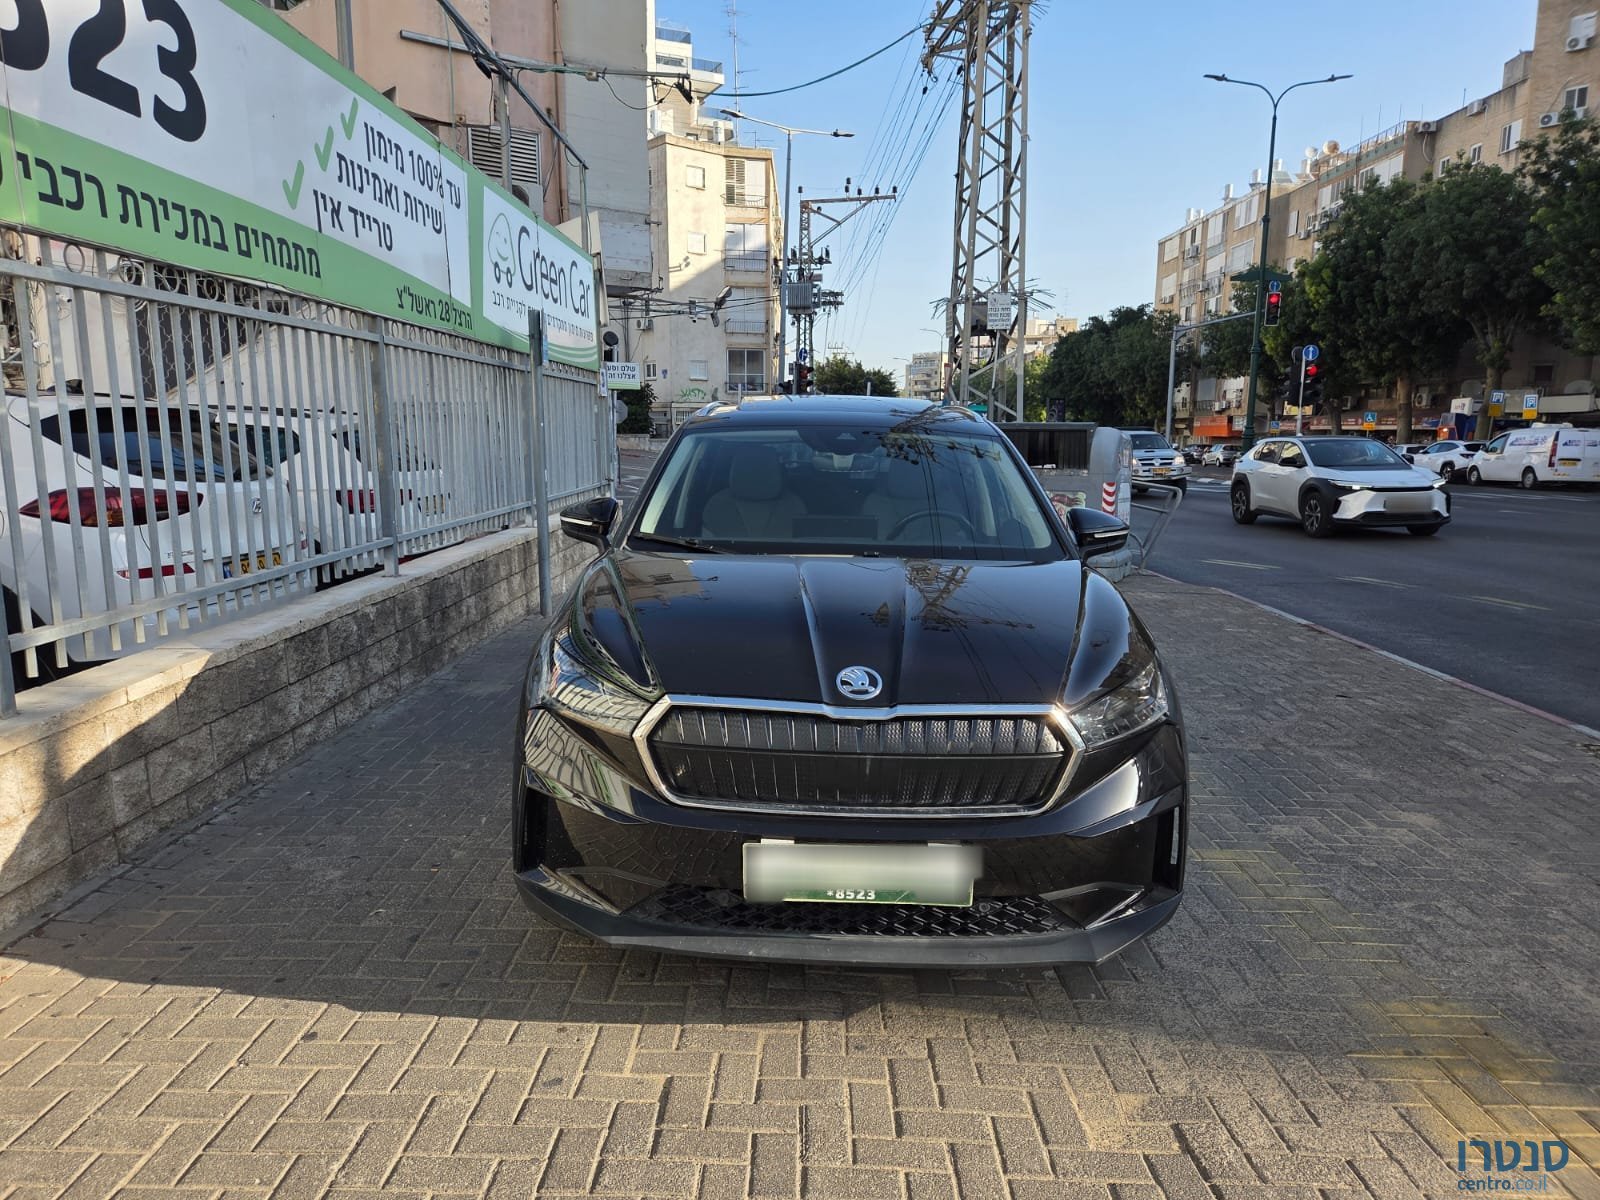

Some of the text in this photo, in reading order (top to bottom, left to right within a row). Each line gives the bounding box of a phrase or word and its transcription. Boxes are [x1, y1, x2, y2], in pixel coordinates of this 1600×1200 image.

[336, 151, 443, 235] שירות ואמינות
[363, 121, 461, 209] עד 100% מימון
[15, 150, 321, 279] מתמחים במכירת רכבי
[312, 188, 393, 252] טרייד אין
[396, 284, 473, 330] הרצל 28 ראשל"צ
[492, 290, 505, 308] רכב
[518, 225, 590, 320] Green Car
